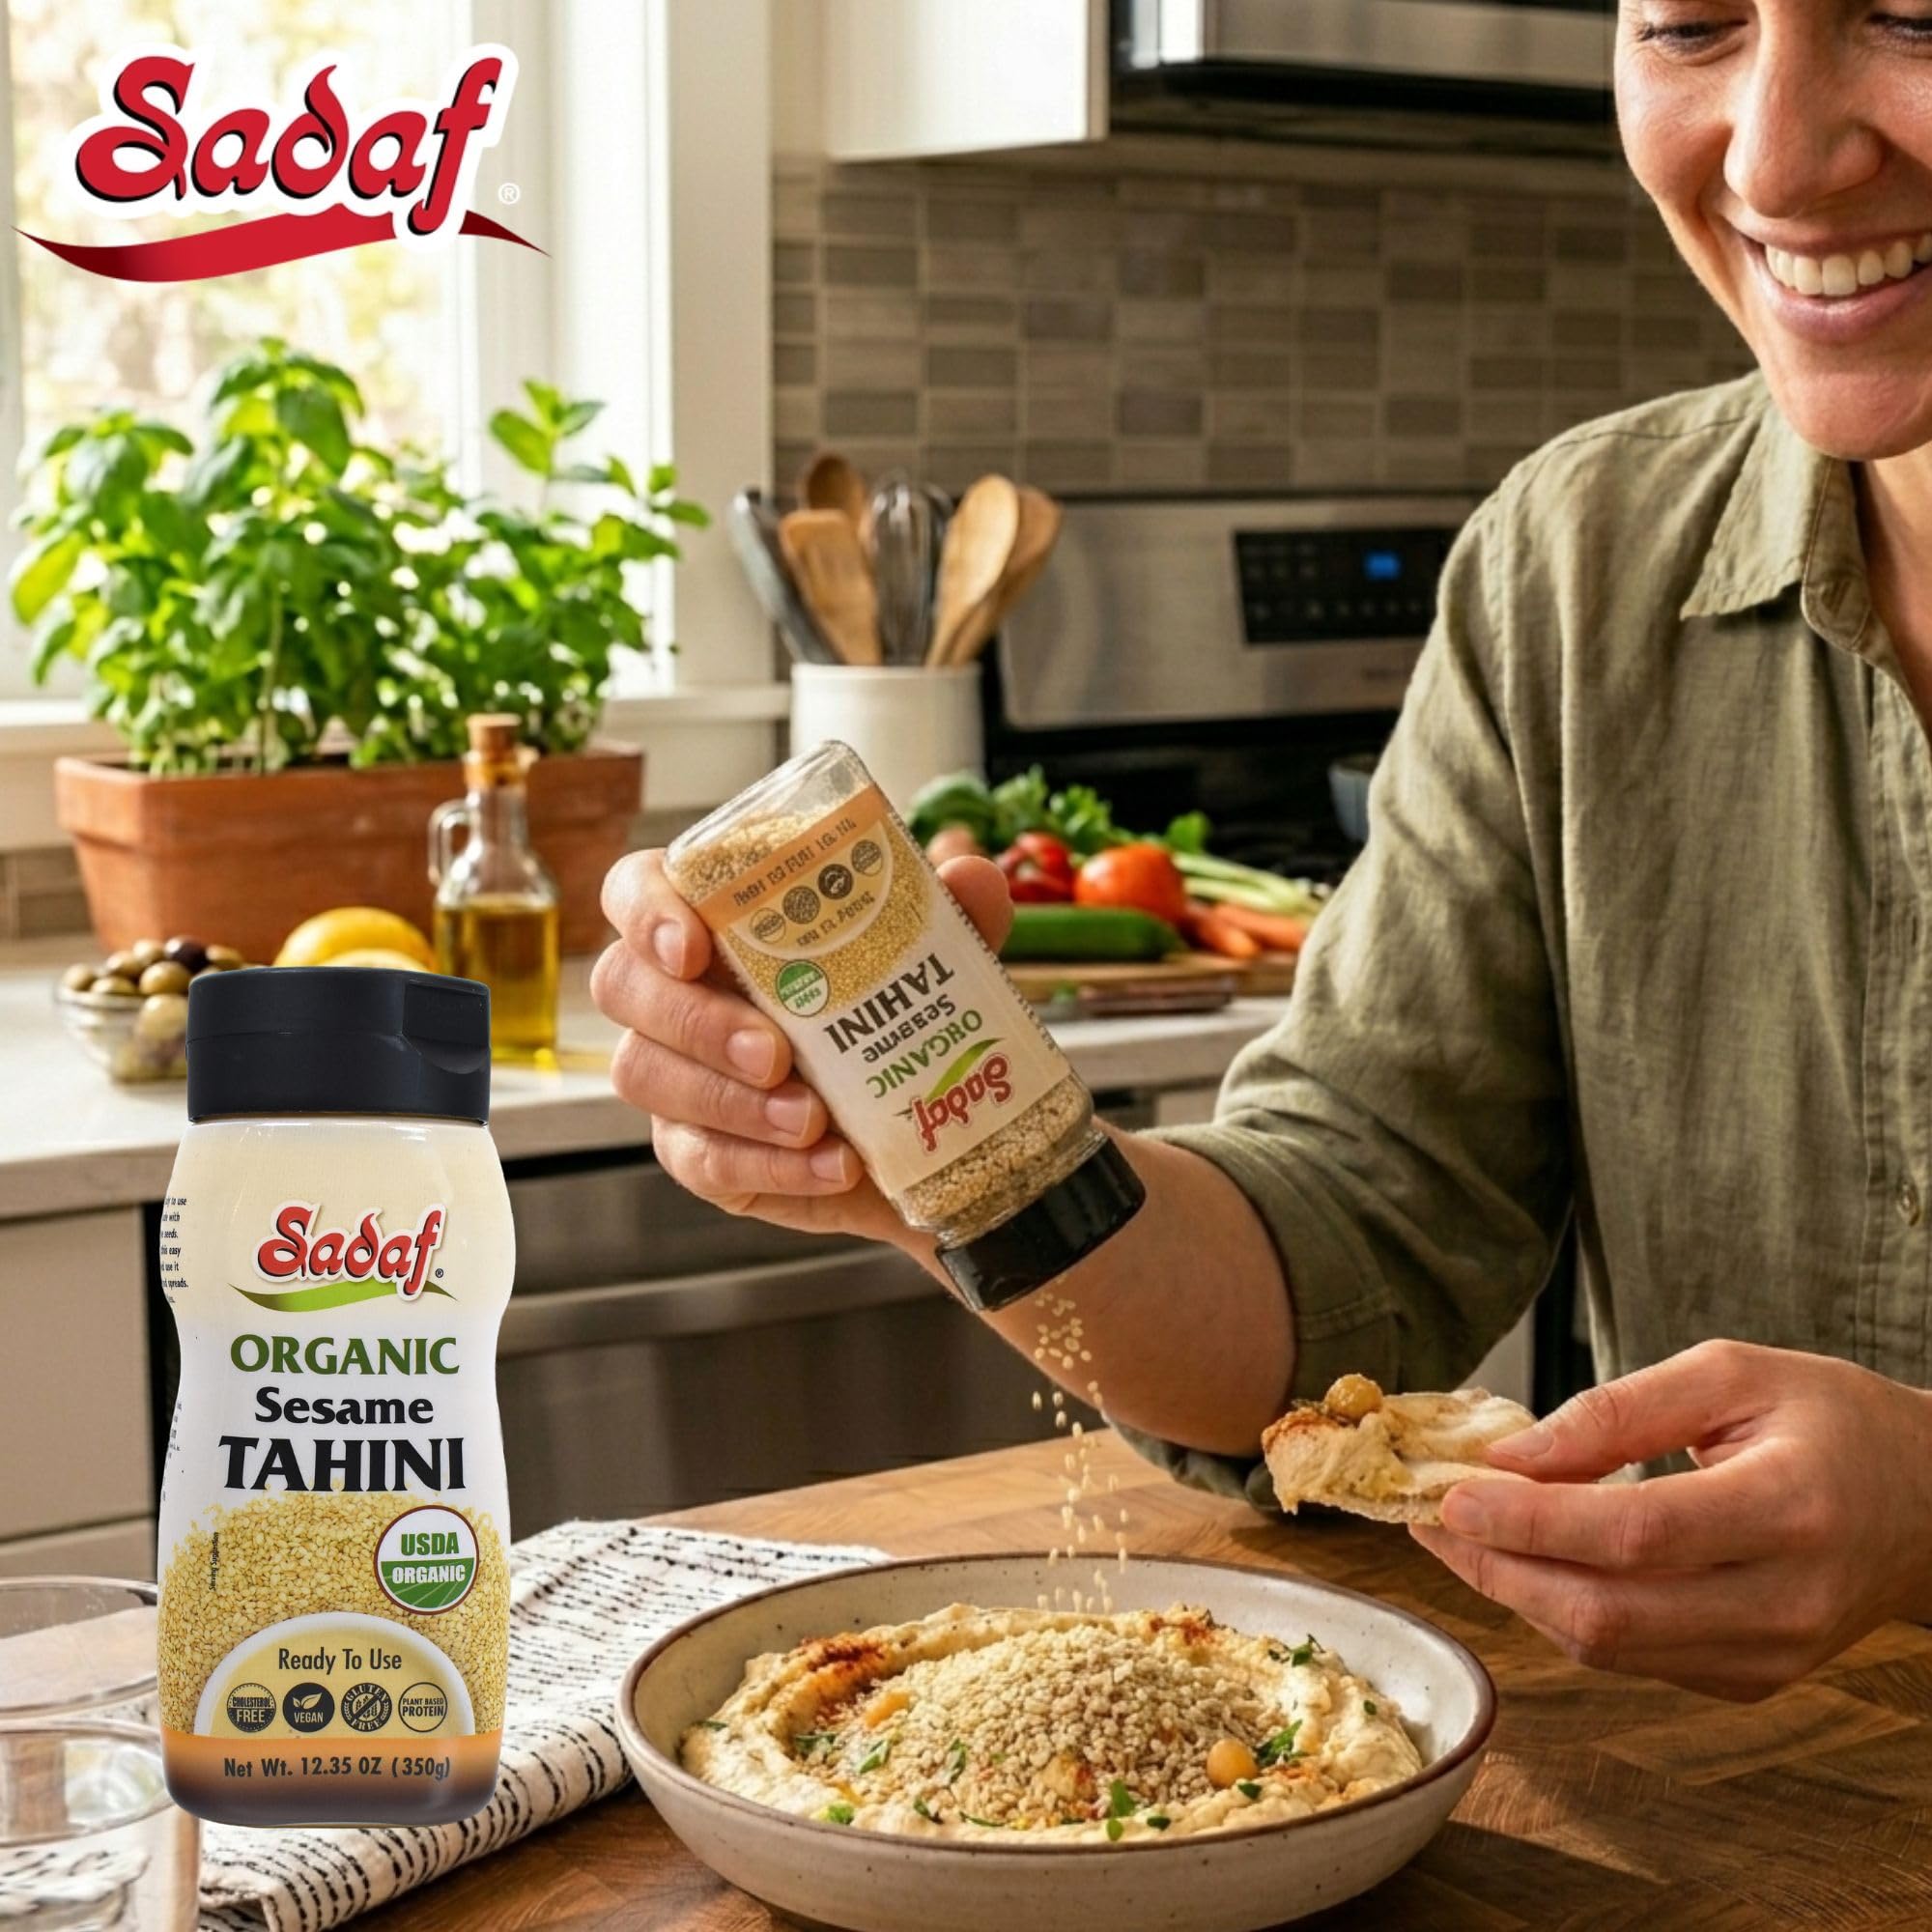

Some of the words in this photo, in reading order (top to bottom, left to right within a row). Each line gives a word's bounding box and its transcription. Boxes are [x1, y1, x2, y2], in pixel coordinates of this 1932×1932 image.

[823, 952, 954, 1054] TAHINI
[169, 1247, 182, 1258] easy
[258, 1206, 441, 1295] Sadaf
[231, 1334, 460, 1376] ORGANIC
[255, 1386, 434, 1425] Sesame
[218, 1435, 467, 1492] TAHINI
[401, 1532, 460, 1556] USDA
[392, 1564, 466, 1584] ORGANIC
[278, 1646, 336, 1675] Ready
[342, 1649, 362, 1670] To
[370, 1647, 402, 1670] Use
[232, 1696, 270, 1708] CHOLESTEROL
[346, 1684, 388, 1701] GLUTEN
[402, 1697, 422, 1706] PLANT
[424, 1697, 444, 1706] BASED
[236, 1709, 266, 1723] FREE
[294, 1712, 324, 1723] VEGAN
[402, 1706, 444, 1717] PROTEIN
[351, 1719, 383, 1730] FREE
[224, 1757, 252, 1777] Net
[261, 1757, 294, 1777] Wt.
[300, 1756, 352, 1776] 12.35
[358, 1756, 383, 1776] OZ
[391, 1756, 451, 1781] (350g)
